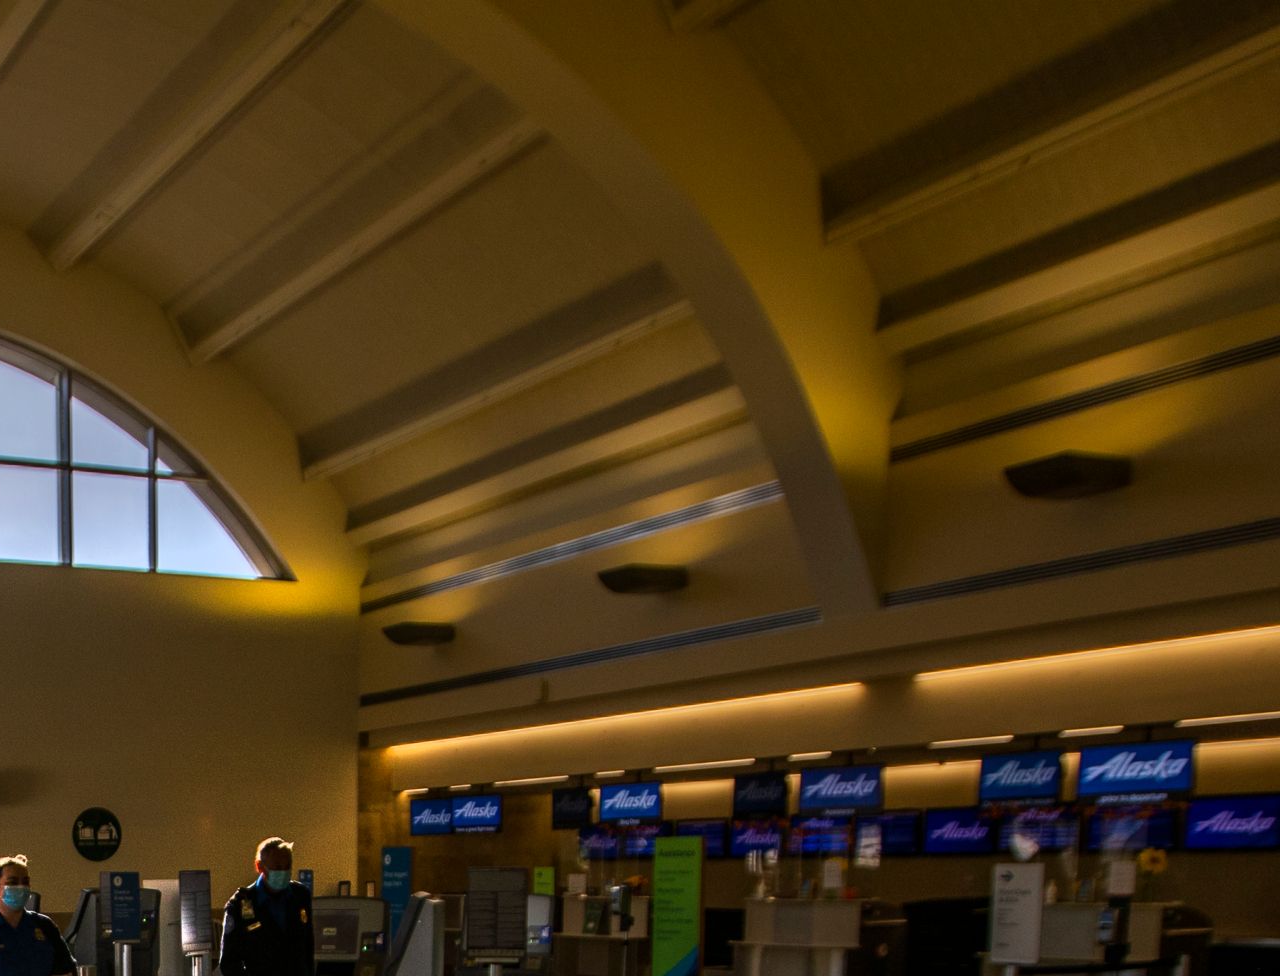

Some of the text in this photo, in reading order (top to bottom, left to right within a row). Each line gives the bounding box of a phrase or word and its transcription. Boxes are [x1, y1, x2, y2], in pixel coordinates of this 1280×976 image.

[982, 759, 1058, 787] Alaska
[1081, 750, 1189, 783] Alaska
[805, 773, 878, 797] Alaska
[453, 801, 499, 818] Alaska
[604, 789, 658, 810] Alaska
[413, 808, 452, 824] Alaska
[1193, 810, 1278, 835] Alaska
[735, 828, 782, 844] Alaska
[930, 820, 990, 841] Alaska
